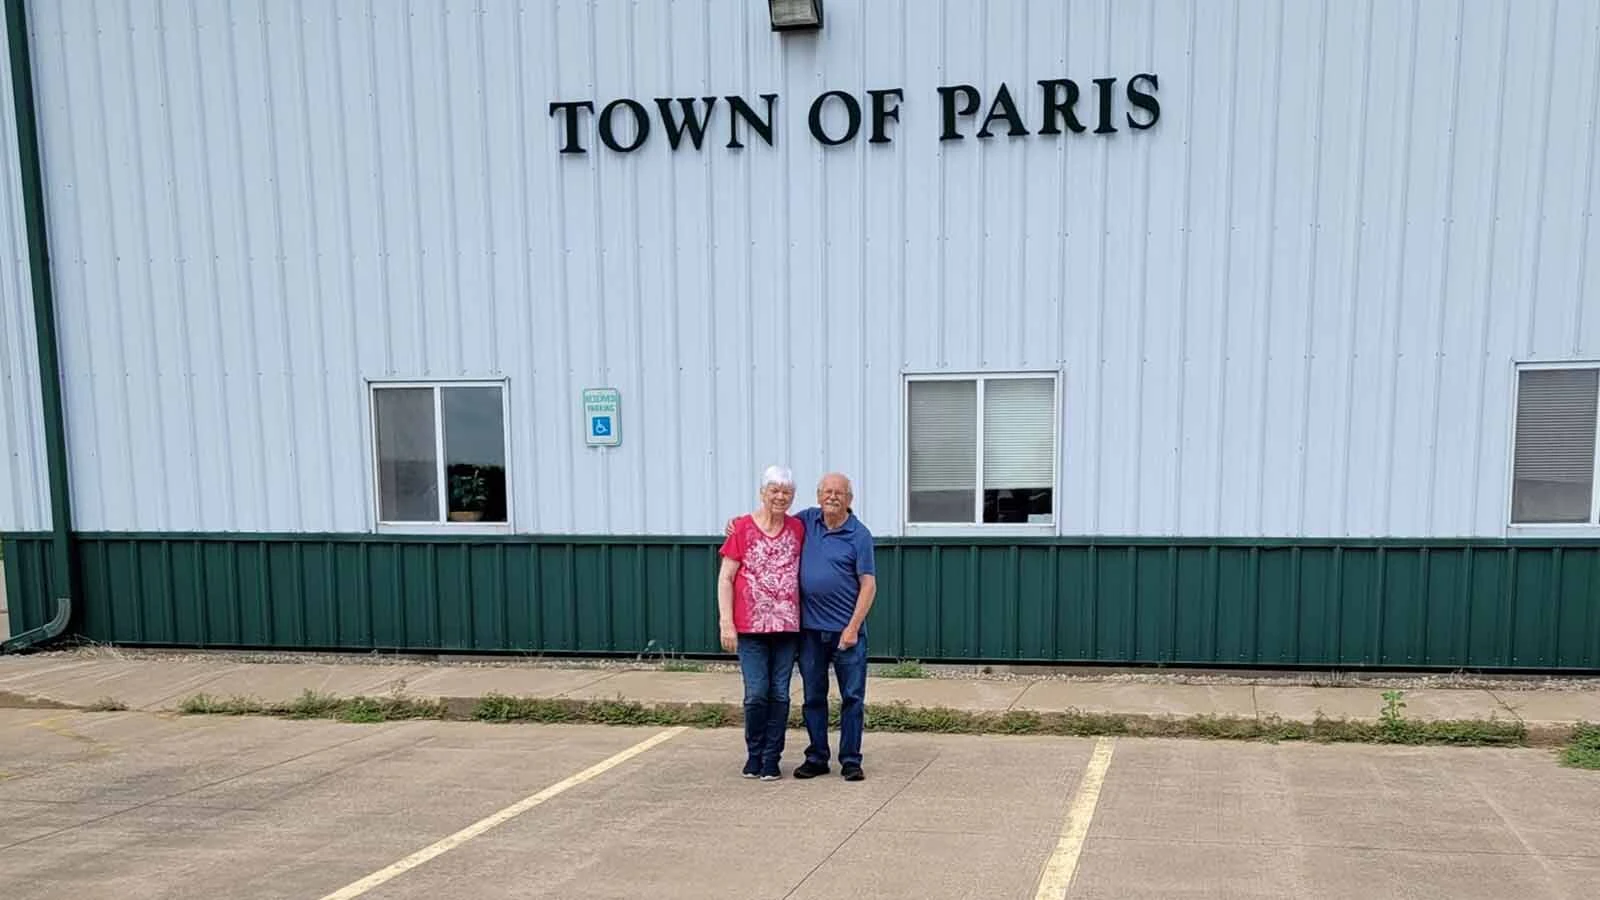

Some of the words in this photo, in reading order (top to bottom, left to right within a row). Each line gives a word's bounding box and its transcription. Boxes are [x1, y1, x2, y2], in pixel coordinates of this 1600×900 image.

[549, 93, 778, 154] TOWN
[808, 88, 903, 146] OF
[937, 73, 1161, 142] PARIS
